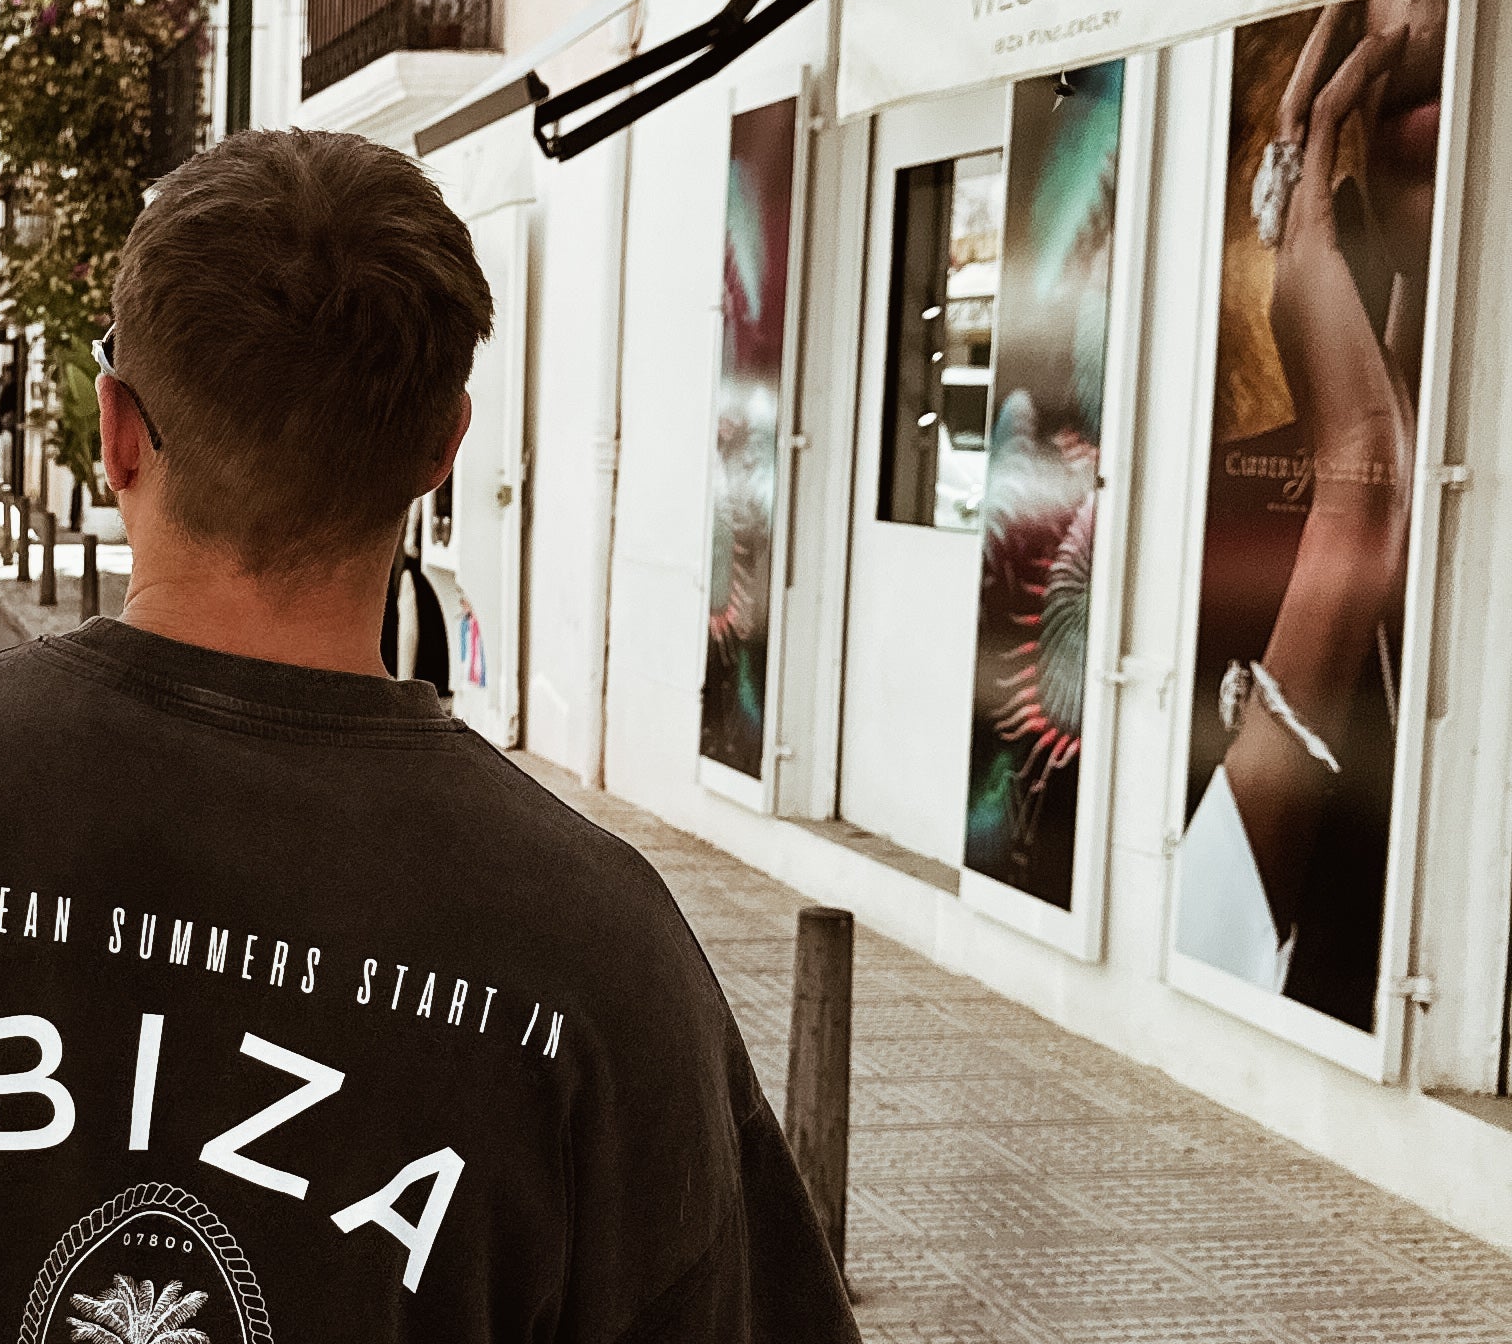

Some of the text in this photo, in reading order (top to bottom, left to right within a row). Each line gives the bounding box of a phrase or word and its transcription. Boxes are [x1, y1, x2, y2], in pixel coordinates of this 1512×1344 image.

[108, 907, 321, 994] SUMMERS
[357, 958, 498, 1034] START
[521, 1002, 565, 1059] IN
[122, 1231, 194, 1254] 07800
